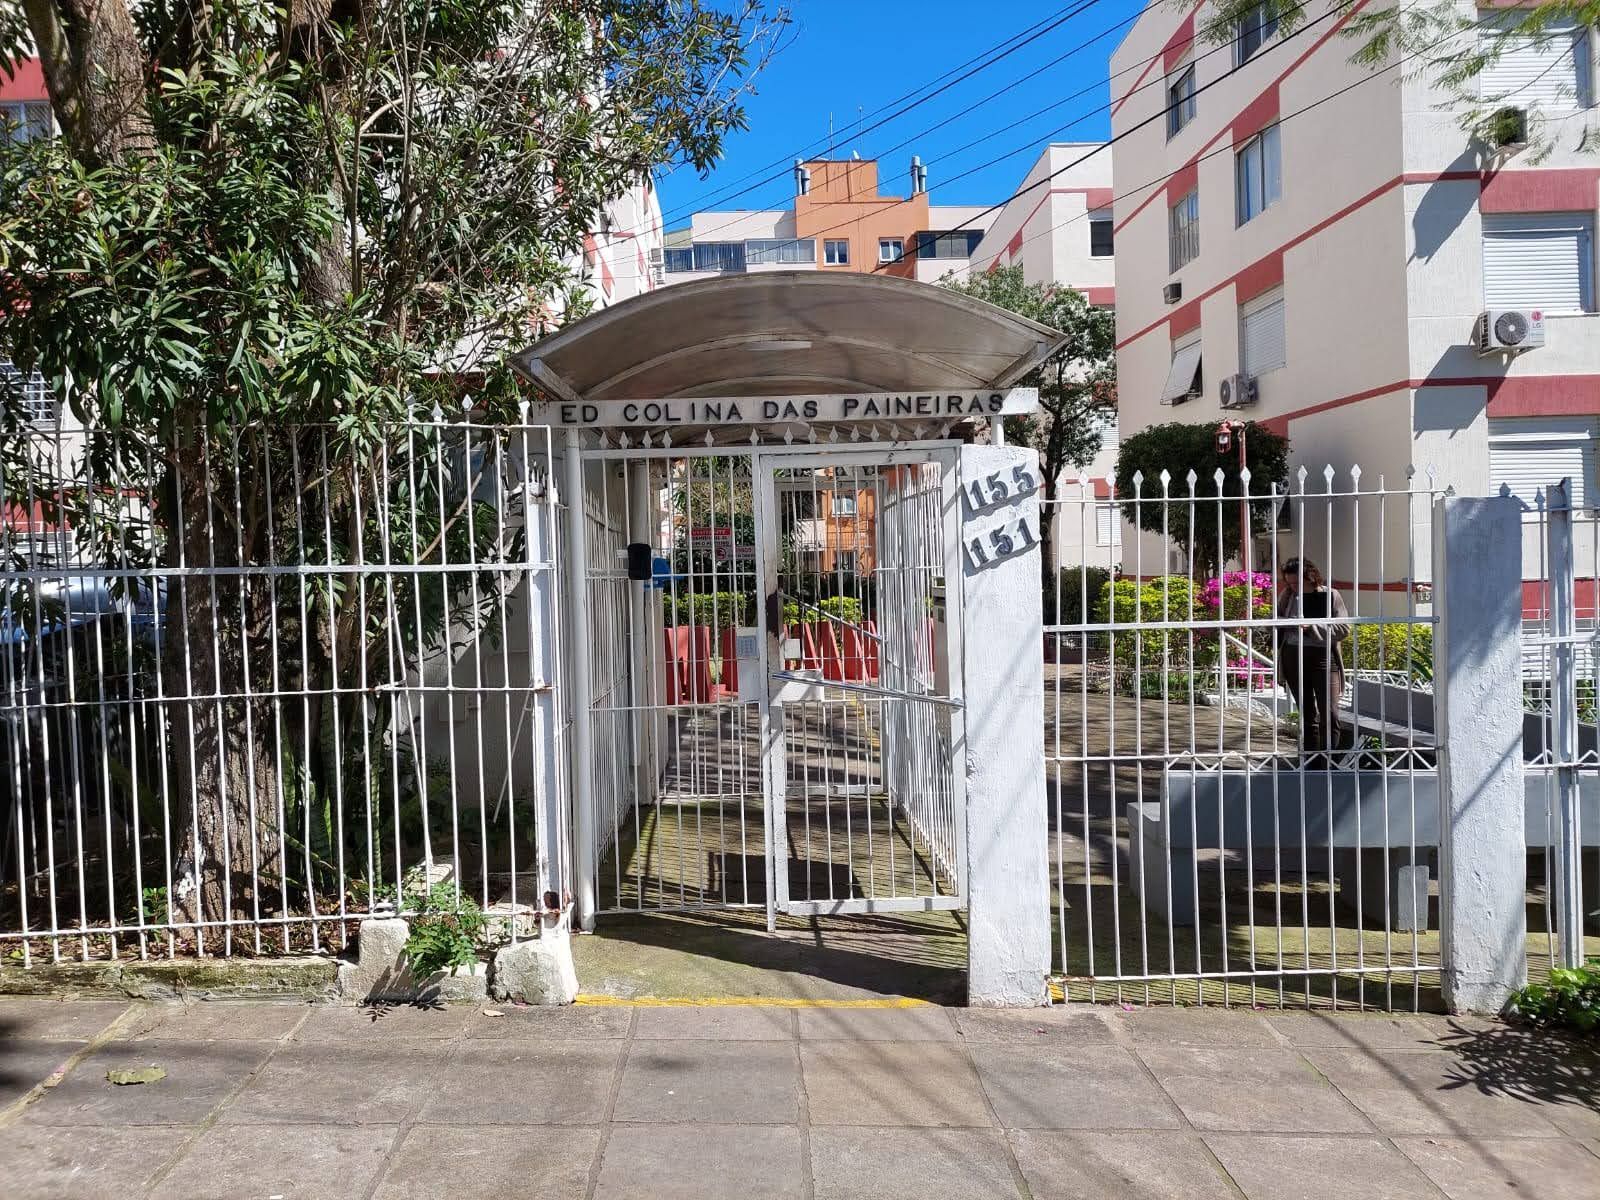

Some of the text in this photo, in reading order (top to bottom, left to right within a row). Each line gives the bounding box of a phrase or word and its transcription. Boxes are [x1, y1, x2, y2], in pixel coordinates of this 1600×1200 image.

[560, 393, 1004, 424] ED COLINA DAS PAINEIRAS
[969, 461, 1035, 508] 155
[970, 517, 1036, 564] 151
